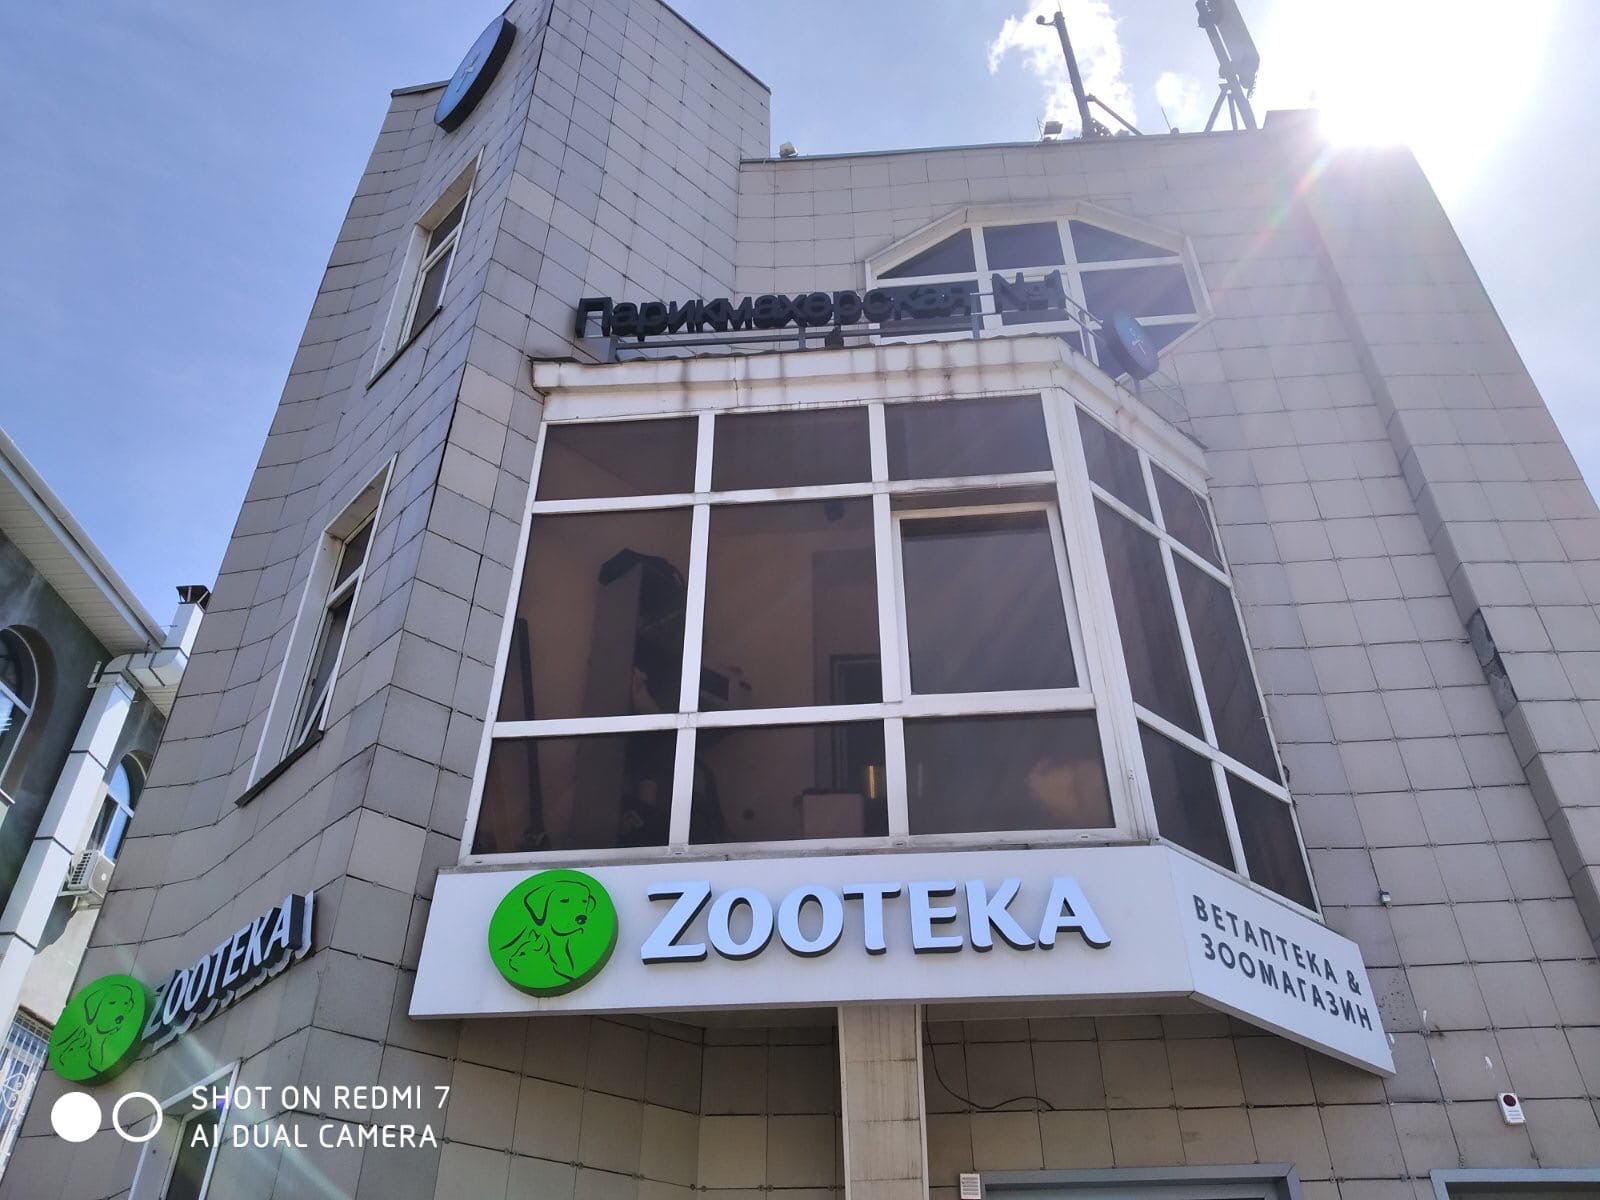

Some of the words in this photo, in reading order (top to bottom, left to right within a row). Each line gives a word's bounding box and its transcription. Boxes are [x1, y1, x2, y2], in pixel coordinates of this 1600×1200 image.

[576, 287, 974, 341] Парикмахерская
[141, 893, 305, 1042] ZOOTEKA
[641, 876, 1111, 964] ZOOTEKA
[1193, 894, 1338, 985] ВЕТАПТЕКА
[1346, 969, 1362, 996] &
[1200, 932, 1373, 1032] ЗООМАГАЗИН
